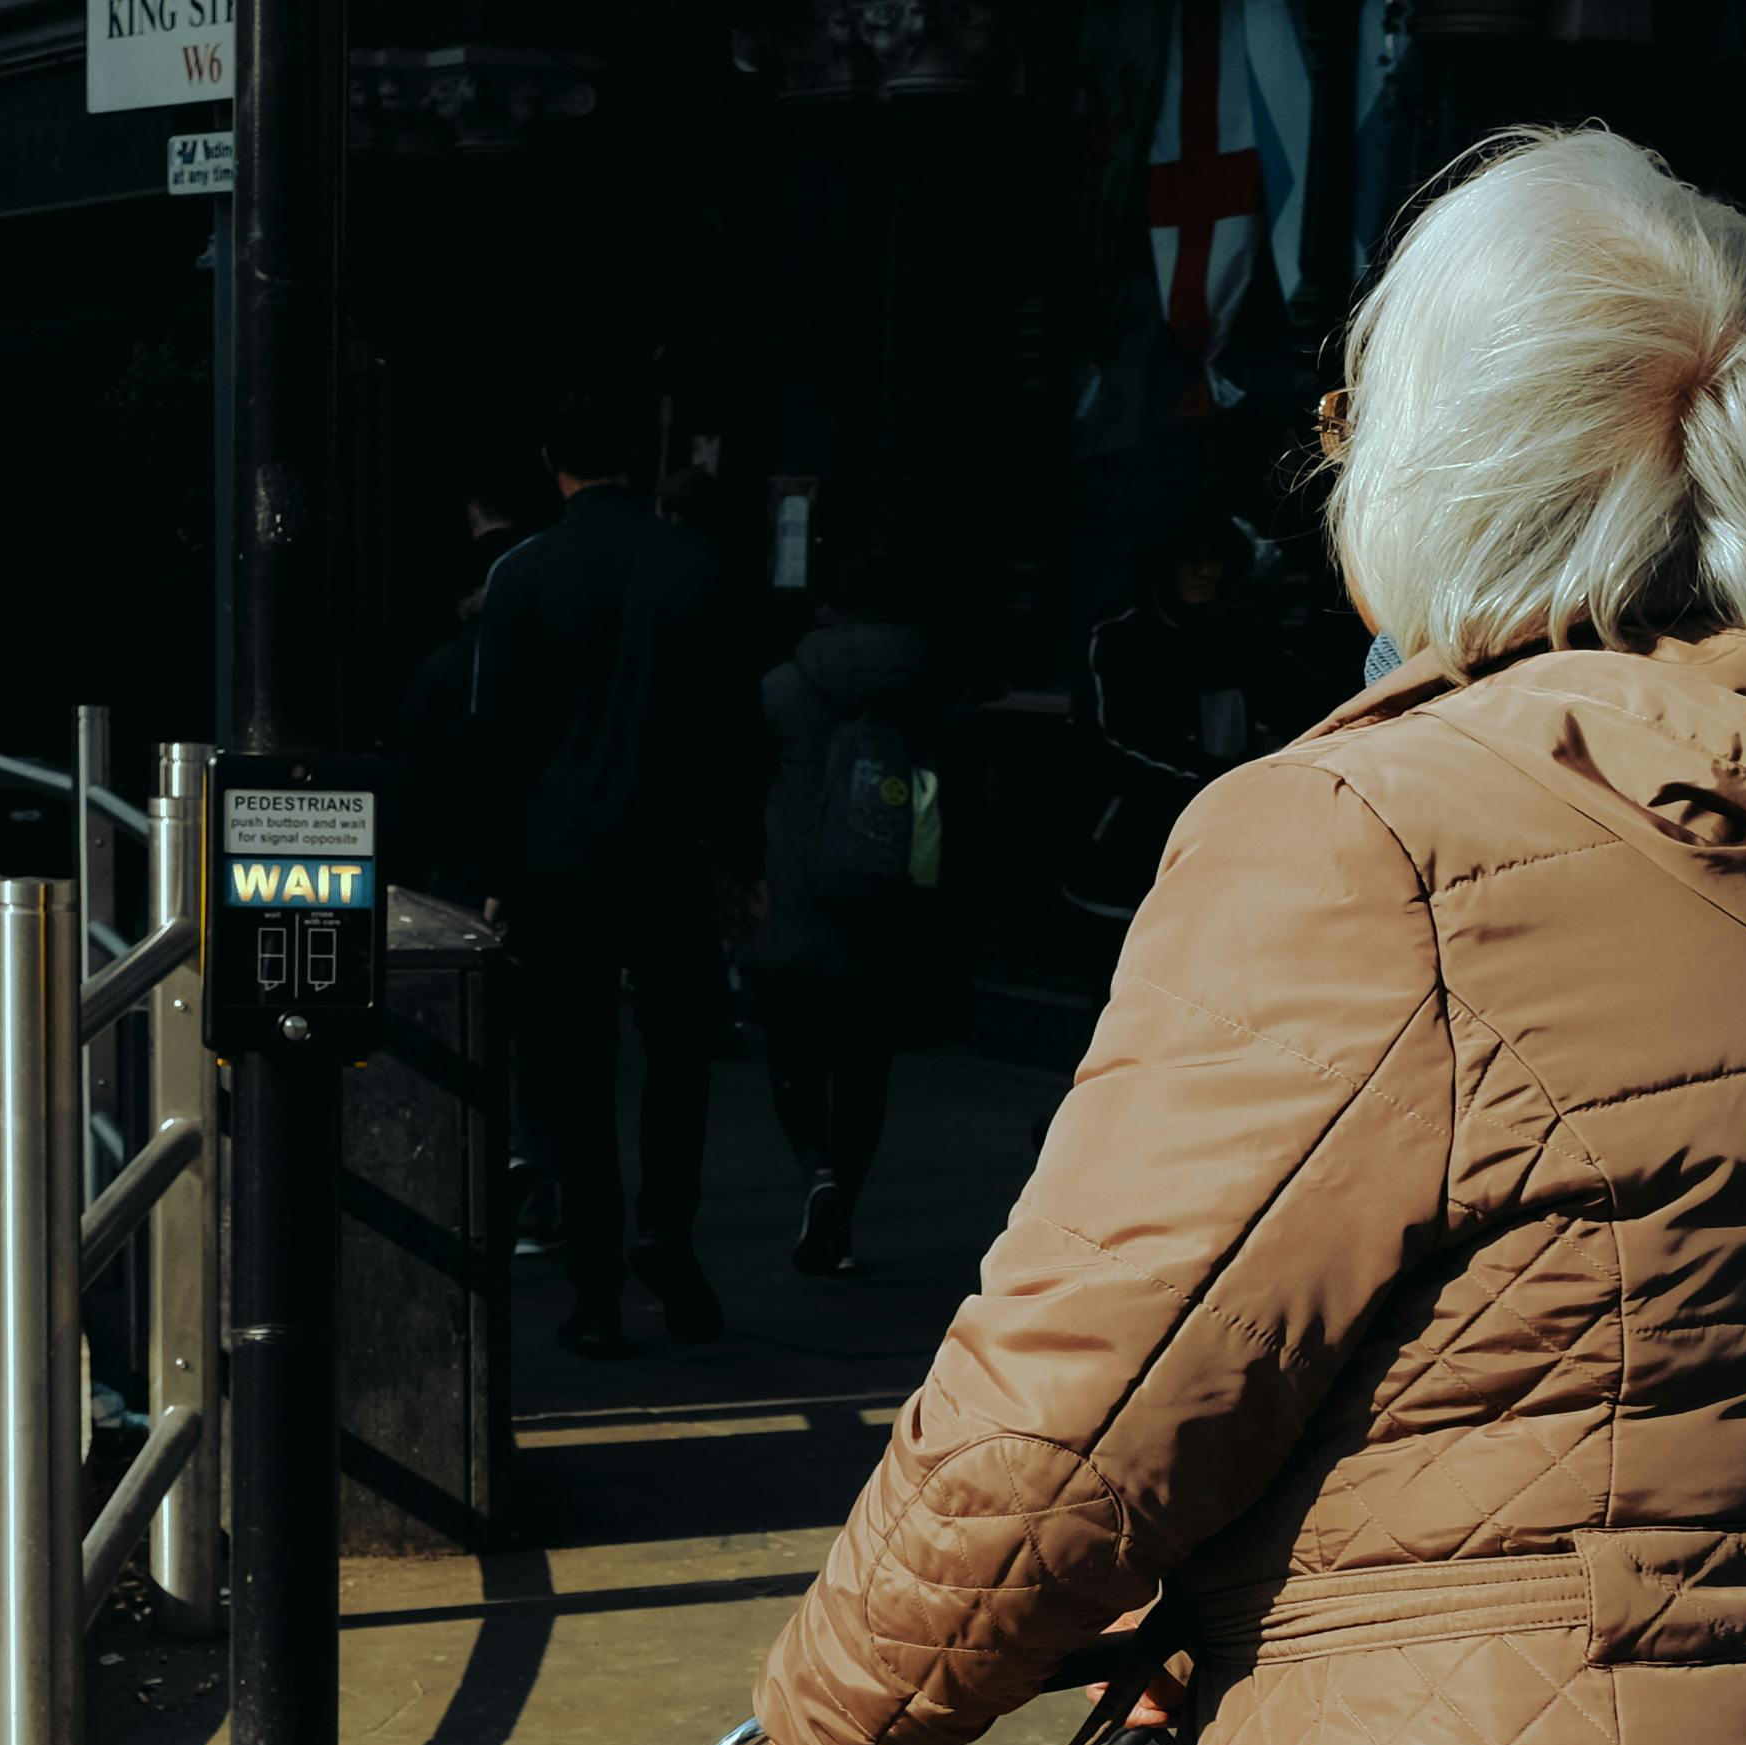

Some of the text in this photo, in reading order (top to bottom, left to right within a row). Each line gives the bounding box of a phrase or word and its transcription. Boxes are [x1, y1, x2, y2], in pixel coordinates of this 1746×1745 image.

[107, 0, 233, 39] KING ST
[182, 42, 224, 85] W6
[189, 170, 208, 187] any
[213, 165, 234, 182] tim
[234, 795, 364, 813] PEDESTRIANS
[230, 816, 367, 830] push button and wait
[238, 831, 359, 846] for signal opposite
[231, 862, 364, 905] WAIT
